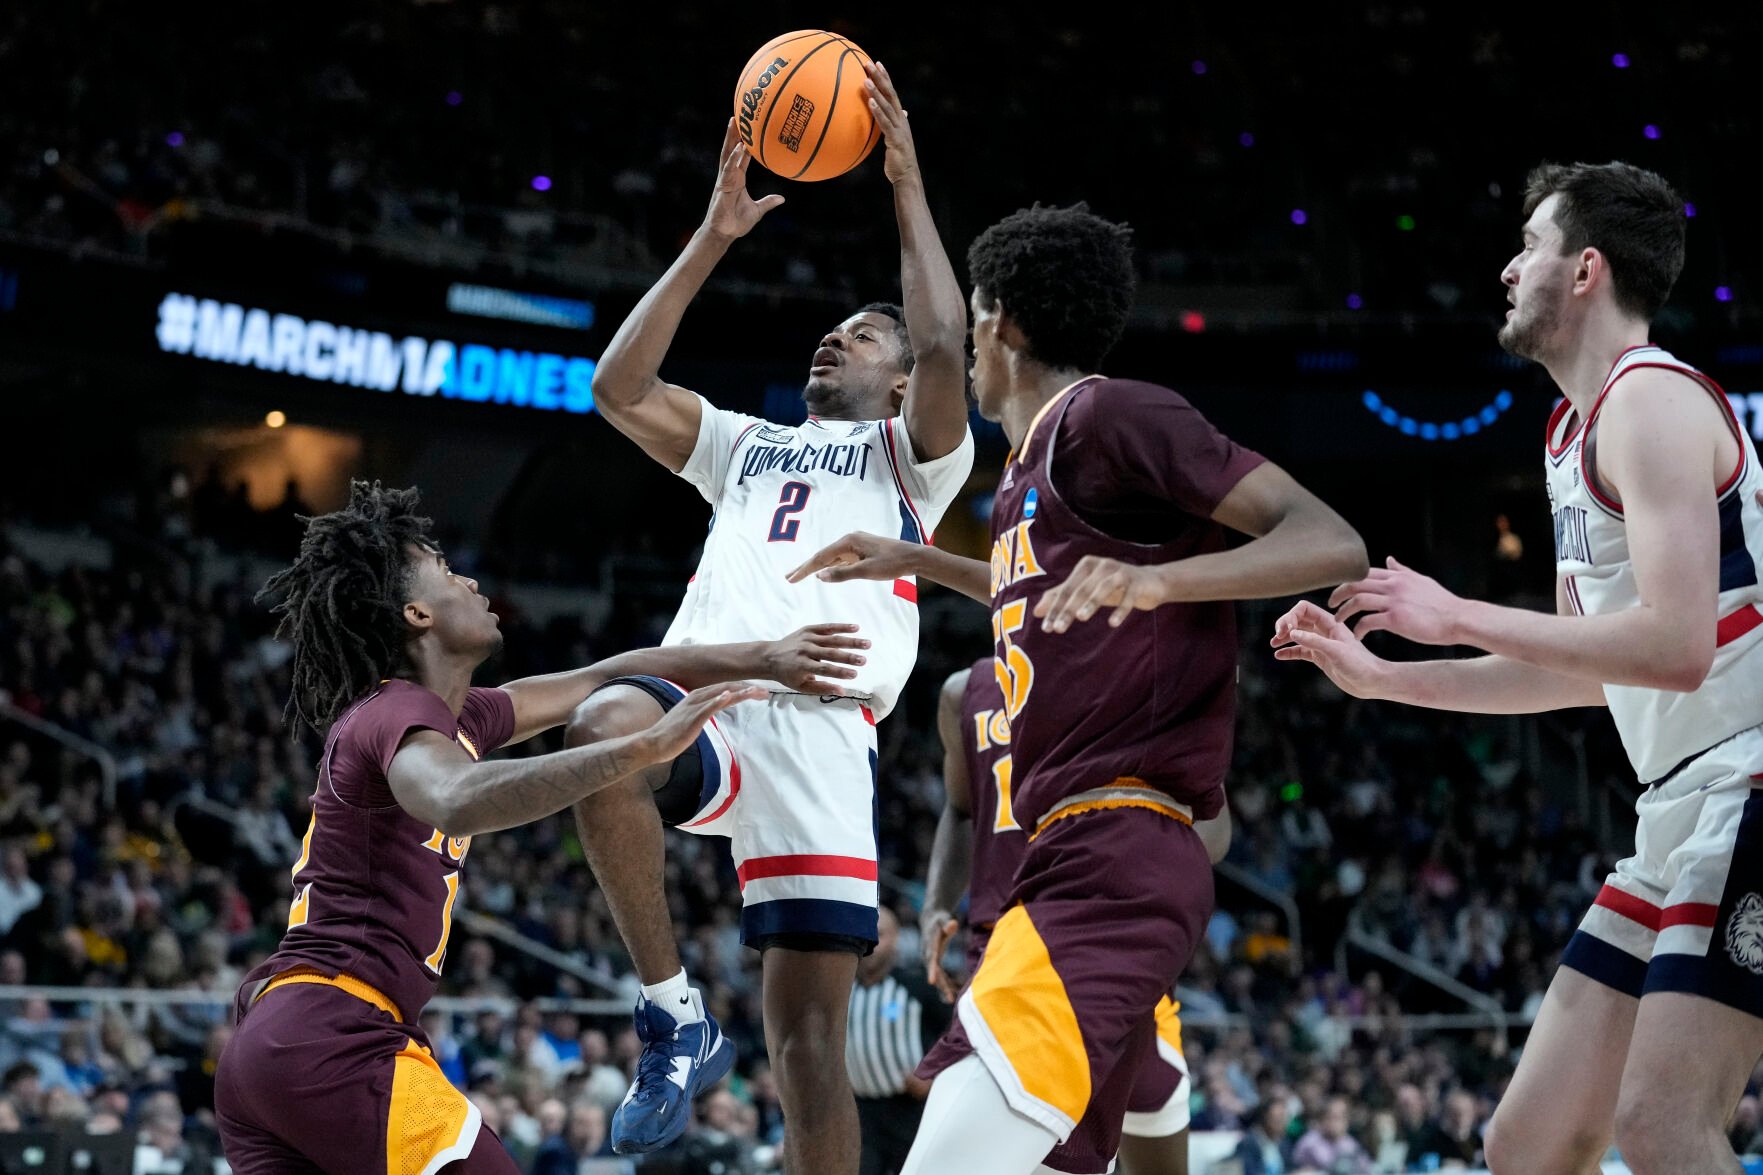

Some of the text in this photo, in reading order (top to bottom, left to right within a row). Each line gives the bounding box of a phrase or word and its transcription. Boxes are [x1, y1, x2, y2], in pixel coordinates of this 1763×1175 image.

[739, 57, 789, 147] Wilson
[782, 109, 800, 138] MARCH
[792, 101, 814, 139] MADNESS
[156, 292, 598, 415] #MARCHMADNES
[767, 481, 811, 542] 2
[991, 518, 1047, 599] ONA
[974, 708, 1012, 753] IO
[992, 753, 1023, 834] 1
